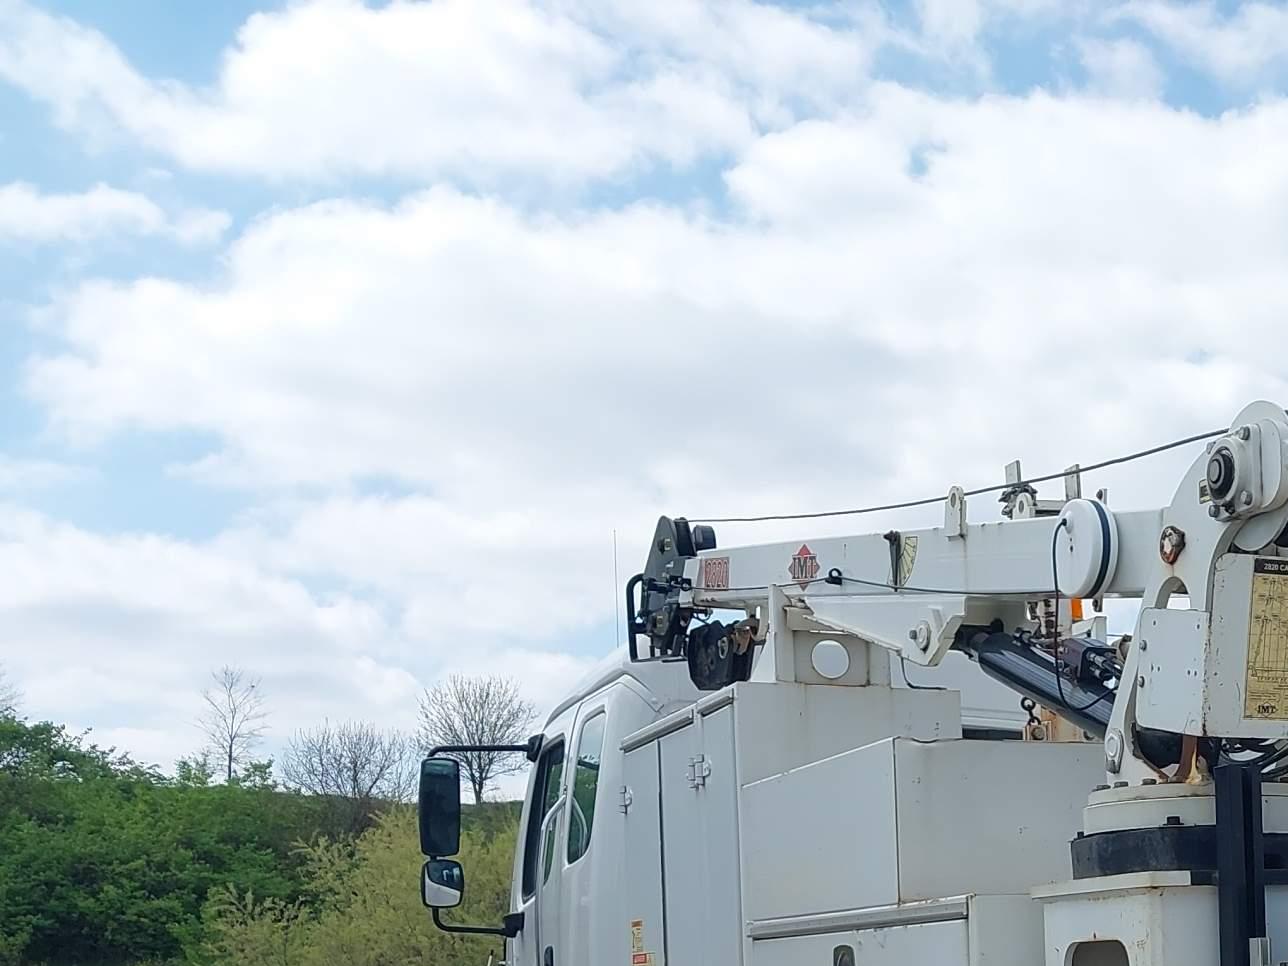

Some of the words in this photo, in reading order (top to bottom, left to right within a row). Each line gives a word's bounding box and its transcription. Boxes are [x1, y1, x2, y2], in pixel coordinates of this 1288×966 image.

[706, 560, 729, 588] 2820
[791, 556, 817, 580] IMT
[1258, 705, 1277, 714] IMT
